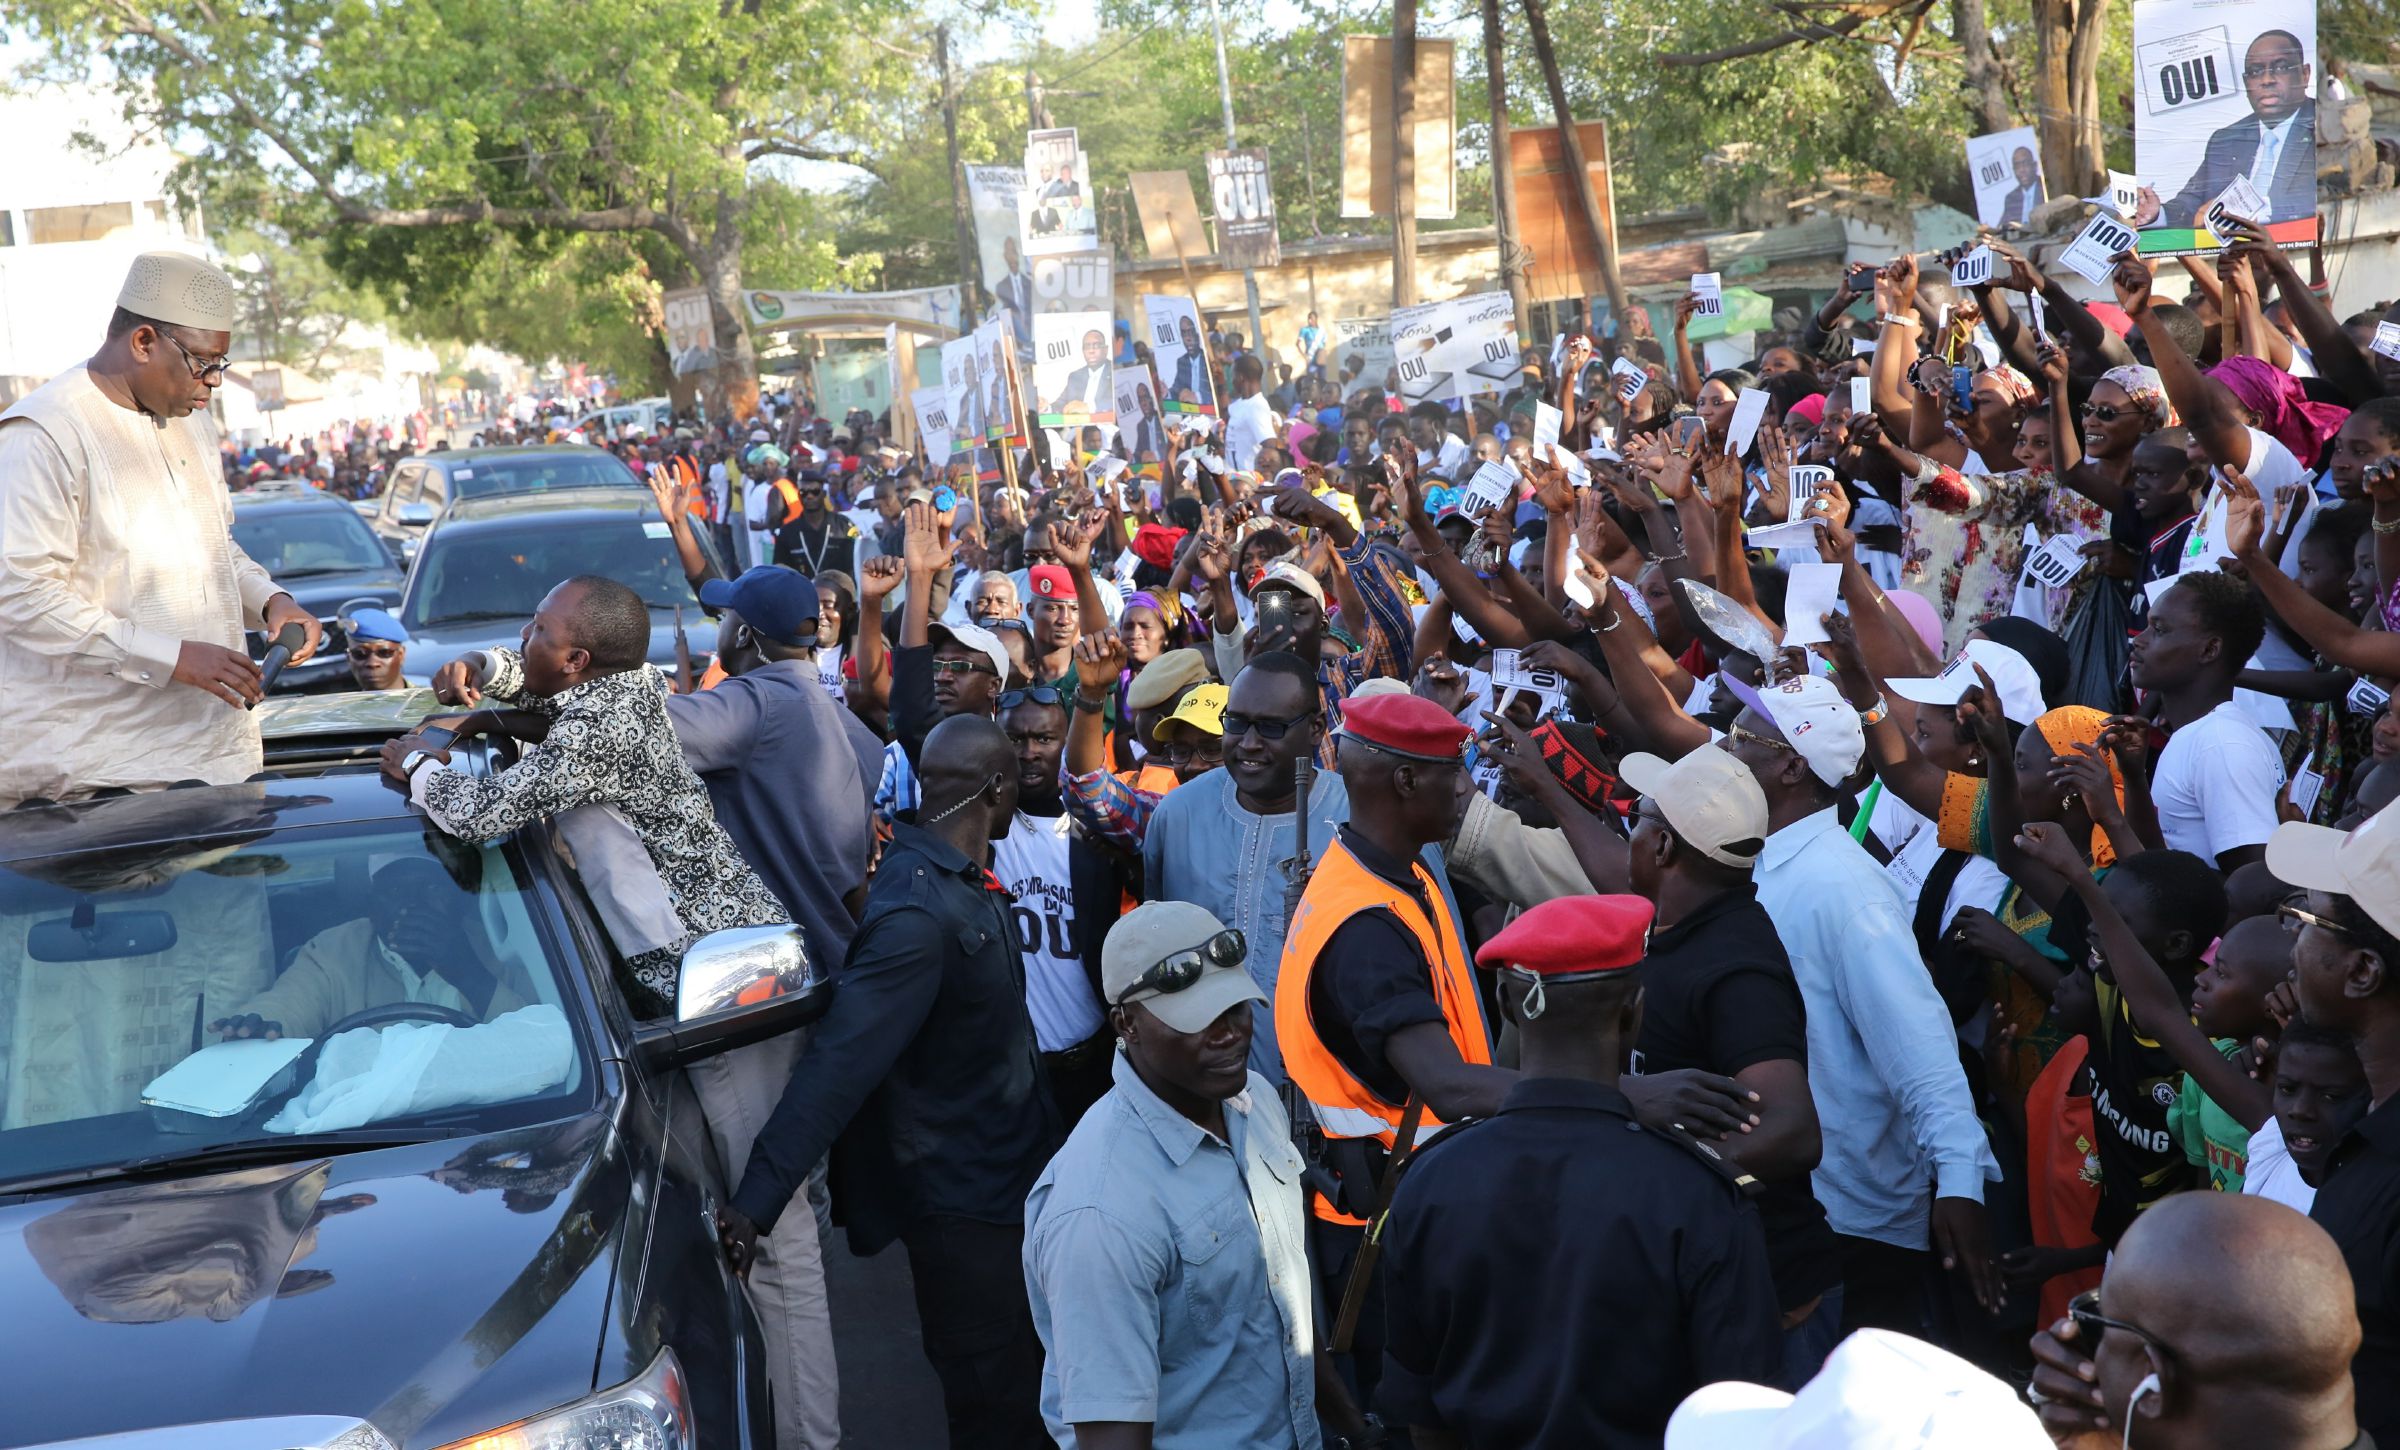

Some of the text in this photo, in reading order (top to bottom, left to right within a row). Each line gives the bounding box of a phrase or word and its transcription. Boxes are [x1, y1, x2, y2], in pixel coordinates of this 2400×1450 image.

[2160, 55, 2219, 105] OUI
[1981, 161, 2004, 185] OUI
[2088, 219, 2132, 252] OUI
[1957, 256, 1986, 281] OUI
[1157, 323, 1175, 344] OUI
[1393, 322, 1432, 341] otons
[1047, 339, 1071, 360] OUI
[1484, 338, 1511, 363] OUI
[1400, 356, 1427, 382] OUI
[1118, 394, 1134, 414] OUI
[926, 410, 948, 430] OUI
[2032, 551, 2070, 585] OUI
[1204, 699, 1219, 709] Sy
[1011, 906, 1081, 961] OU
